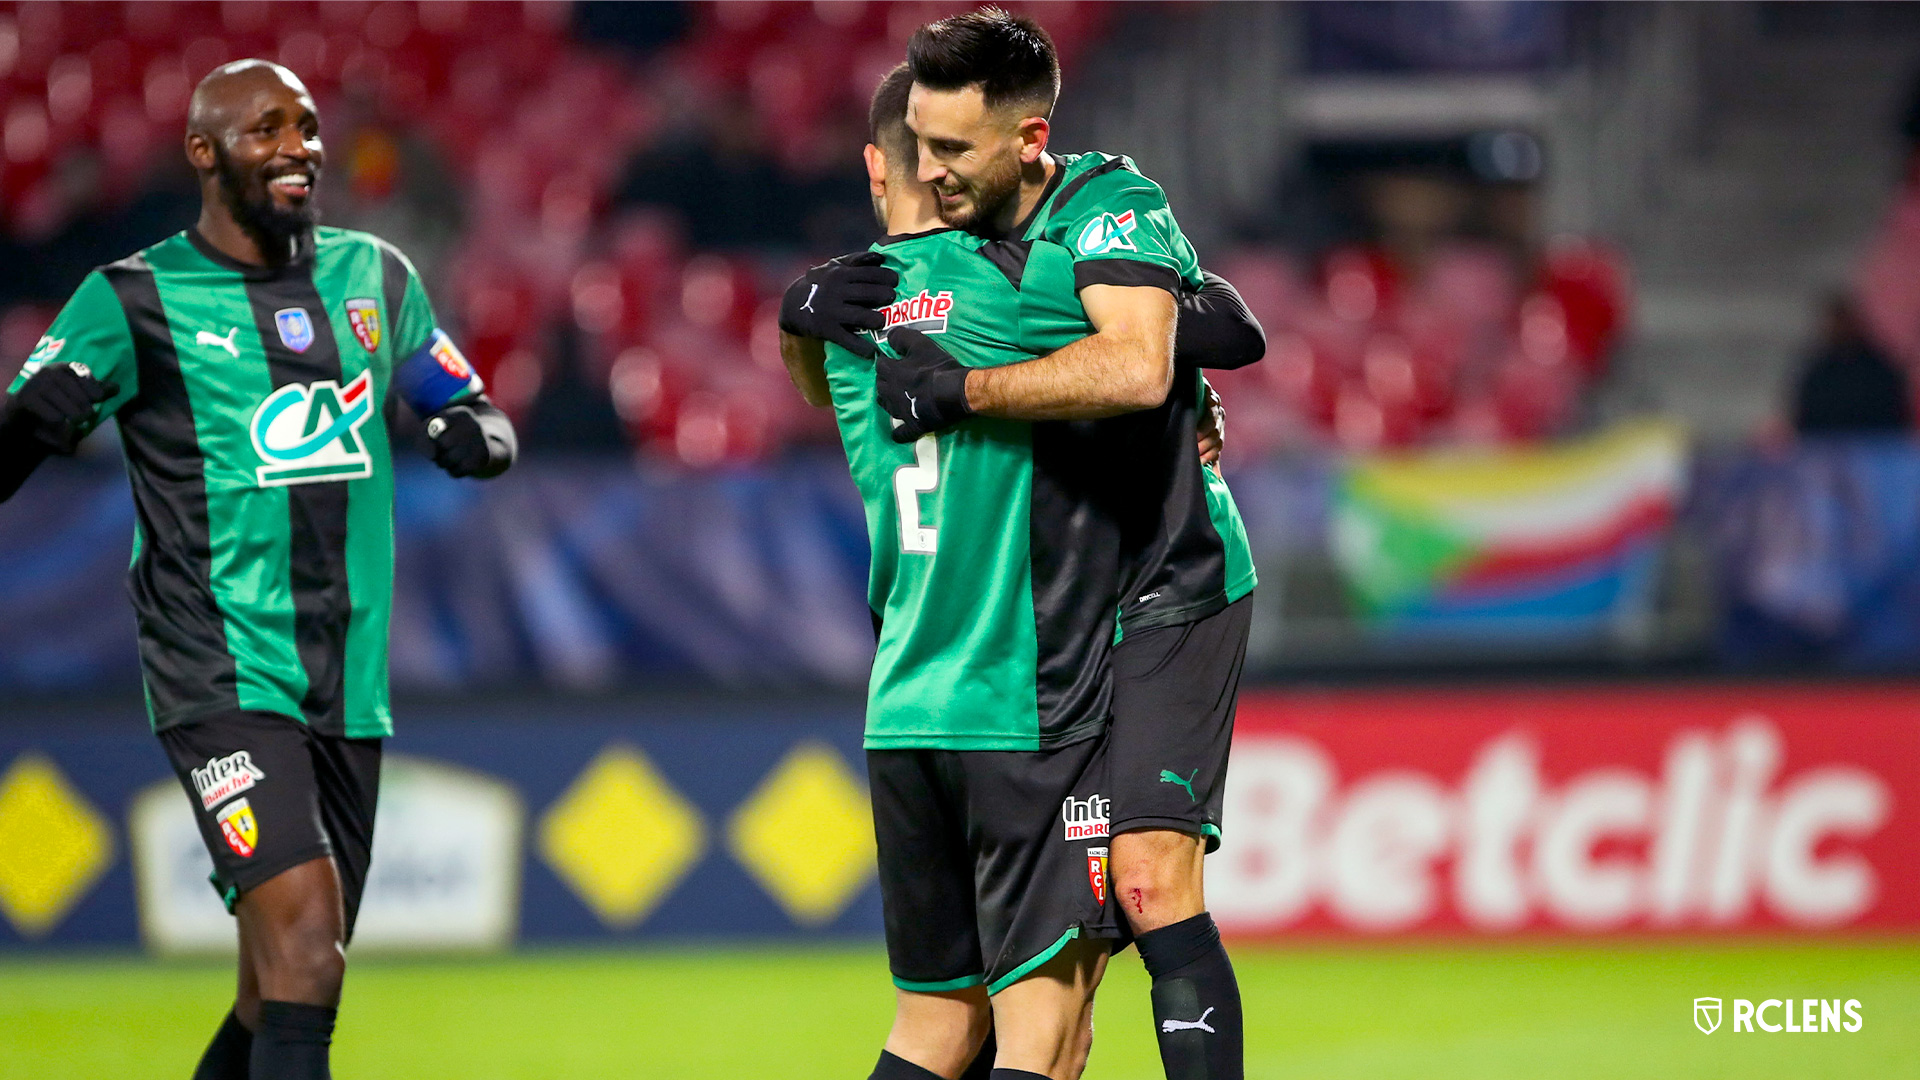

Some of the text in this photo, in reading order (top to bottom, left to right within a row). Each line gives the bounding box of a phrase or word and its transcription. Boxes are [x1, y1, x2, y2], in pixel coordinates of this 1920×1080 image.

[893, 417, 939, 555] 2
[1090, 860, 1104, 900] RCL
[1203, 718, 1886, 928] Betclic
